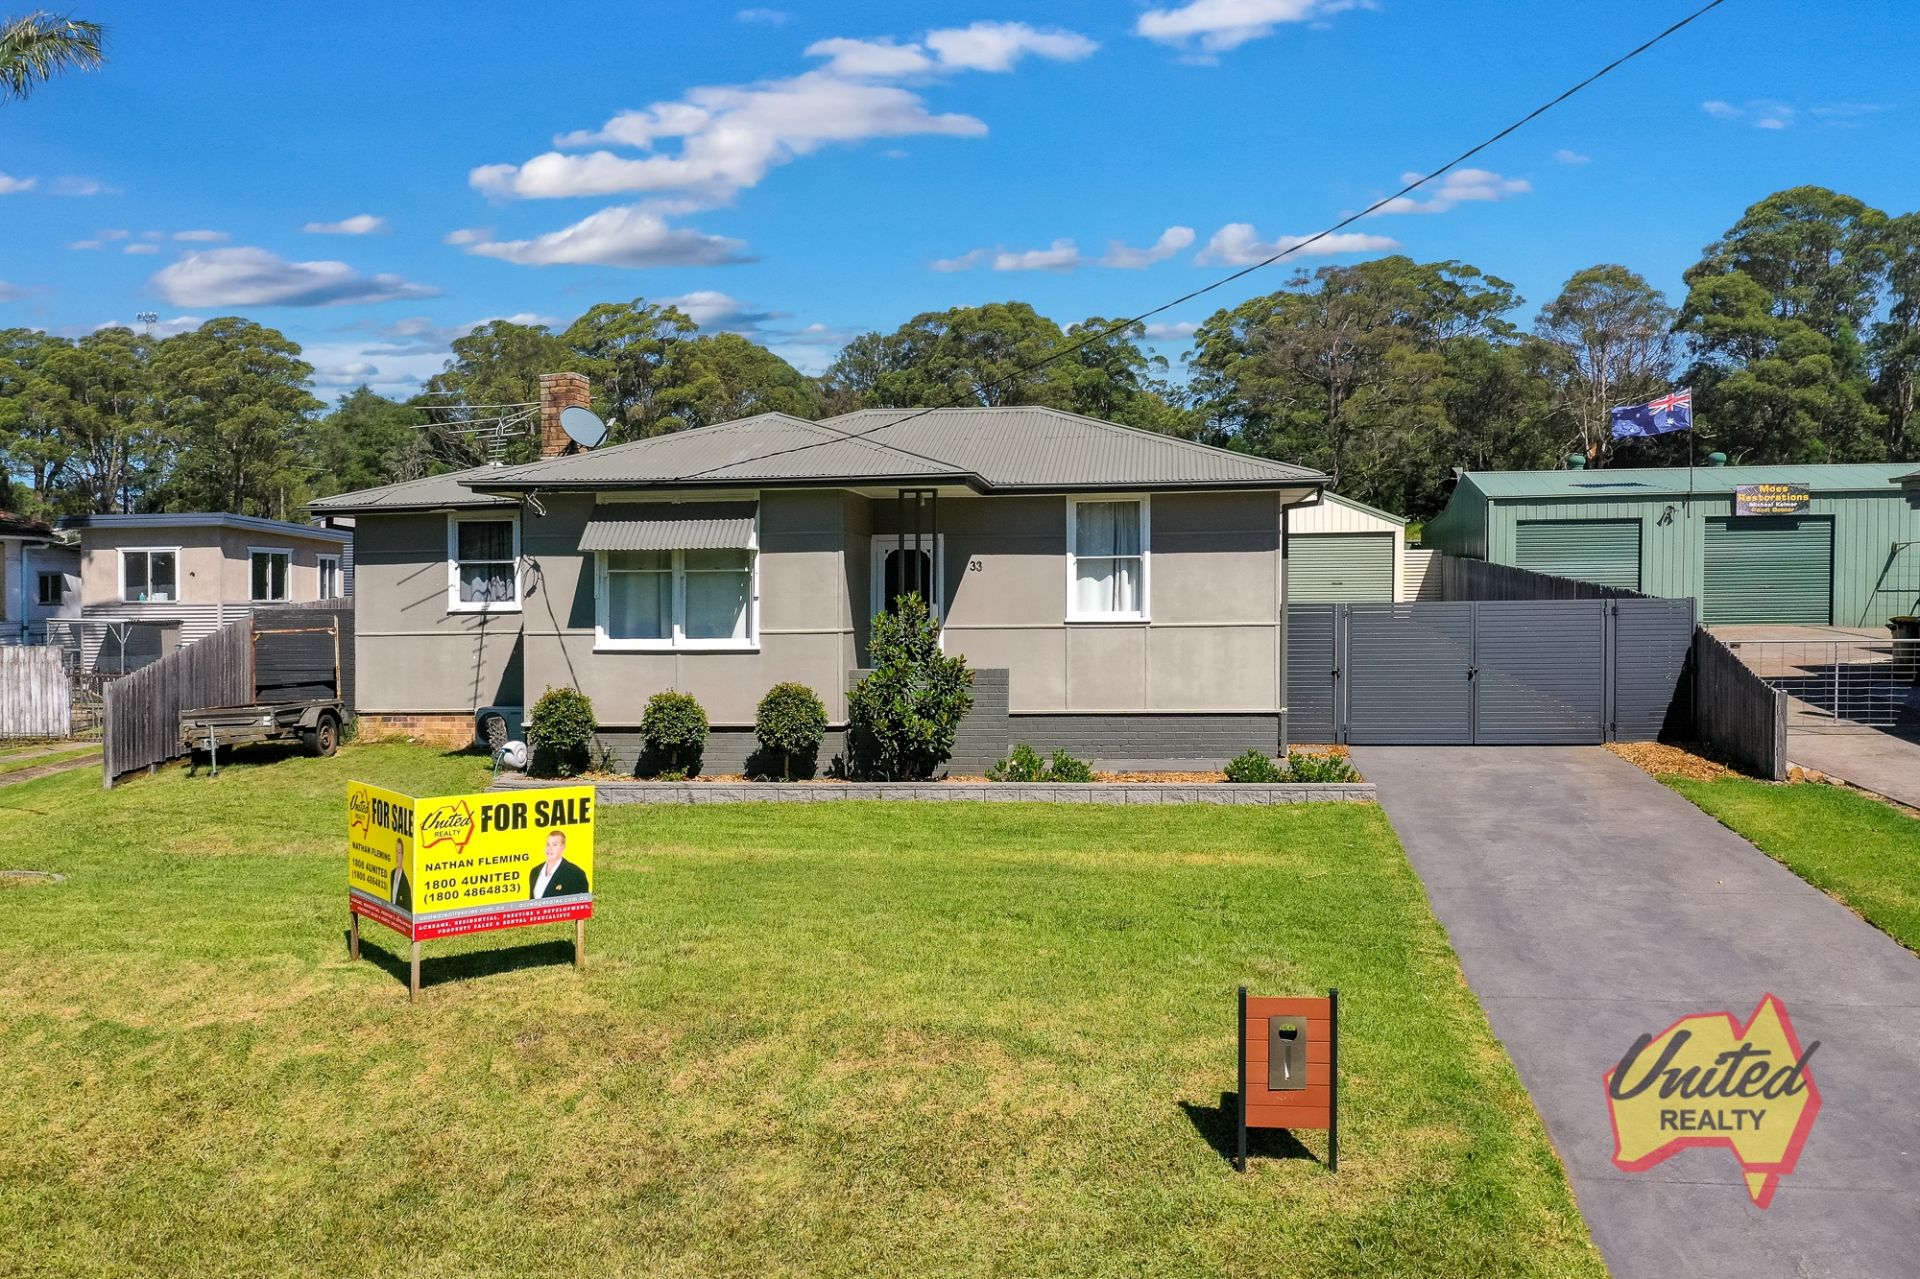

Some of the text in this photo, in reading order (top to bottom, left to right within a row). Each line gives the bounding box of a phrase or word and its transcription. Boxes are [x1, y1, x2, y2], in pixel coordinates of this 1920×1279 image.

[1738, 494, 1809, 502] Restorations
[970, 561, 982, 572] 33
[372, 798, 414, 838] FOR SALE
[421, 811, 475, 831] United
[481, 797, 591, 833] FOR SALE
[434, 830, 461, 838] REALTY
[352, 842, 391, 862] NATHAN FLEMING
[352, 857, 387, 878] 1800 4UNITED
[425, 853, 530, 872] NATHAN FLEMING
[424, 871, 520, 891] 1800 4UNITED
[423, 891, 459, 904] (1800
[463, 883, 521, 897] 4864833)
[437, 925, 471, 934] PROPERTY
[474, 921, 493, 929] SALES
[502, 918, 527, 926] RENTAL
[530, 913, 570, 922] SPECIALISTS
[502, 910, 534, 919] PRESTIGE
